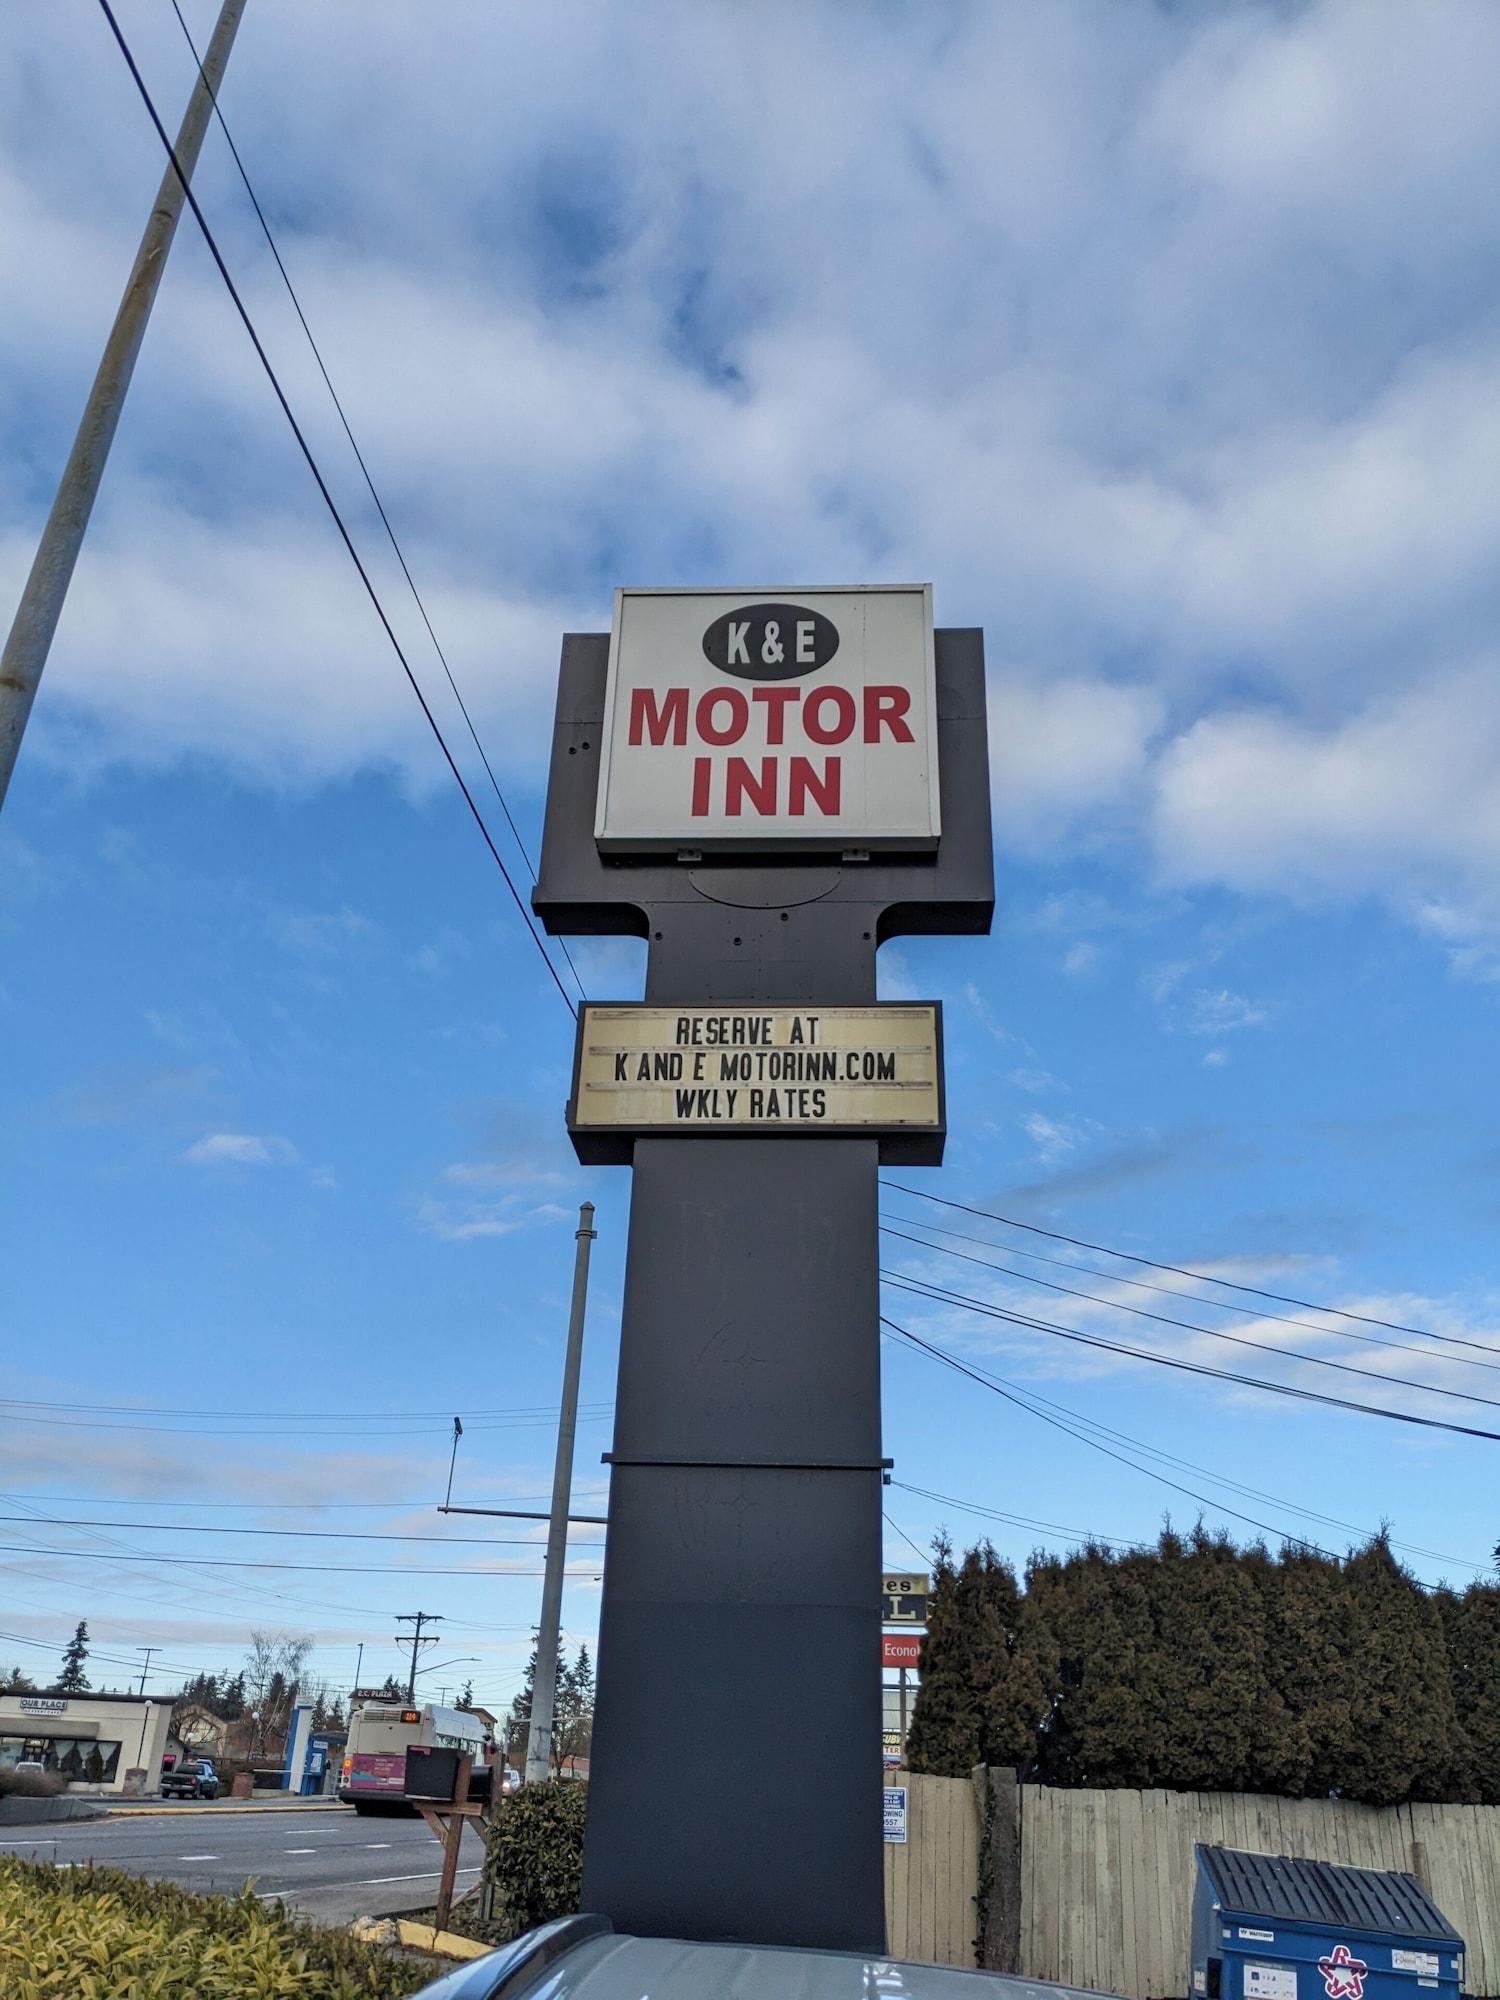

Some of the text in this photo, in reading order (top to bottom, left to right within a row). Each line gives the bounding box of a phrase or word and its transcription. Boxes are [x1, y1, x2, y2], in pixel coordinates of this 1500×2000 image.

[628, 685, 916, 746] MOTOR
[691, 756, 842, 817] INN
[676, 1016, 819, 1045] RESERVE AT
[614, 1051, 896, 1081] K AND E MOTORINN.COM
[676, 1088, 826, 1118] WKLY RATES
[883, 1580, 911, 1592] es
[21, 1699, 66, 1708] OUR PLACE
[883, 1818, 897, 1826] 557
